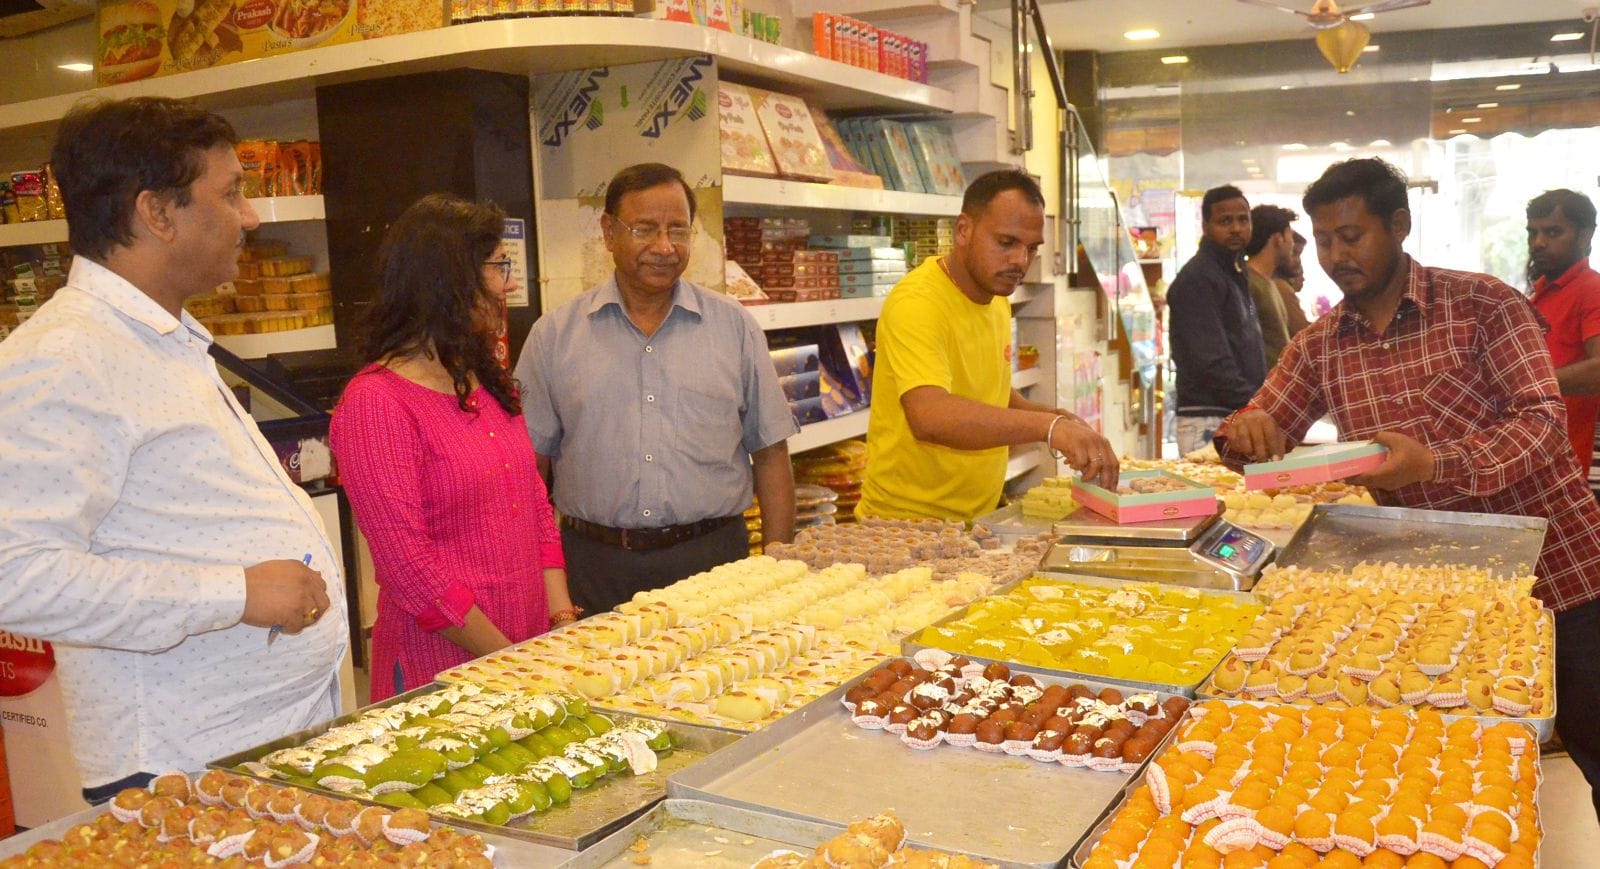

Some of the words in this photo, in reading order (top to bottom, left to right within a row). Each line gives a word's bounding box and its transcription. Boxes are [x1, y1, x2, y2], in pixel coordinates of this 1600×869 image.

[0, 660, 16, 680] TS
[2, 710, 36, 725] CERTIFIED
[36, 717, 48, 728] CO.
